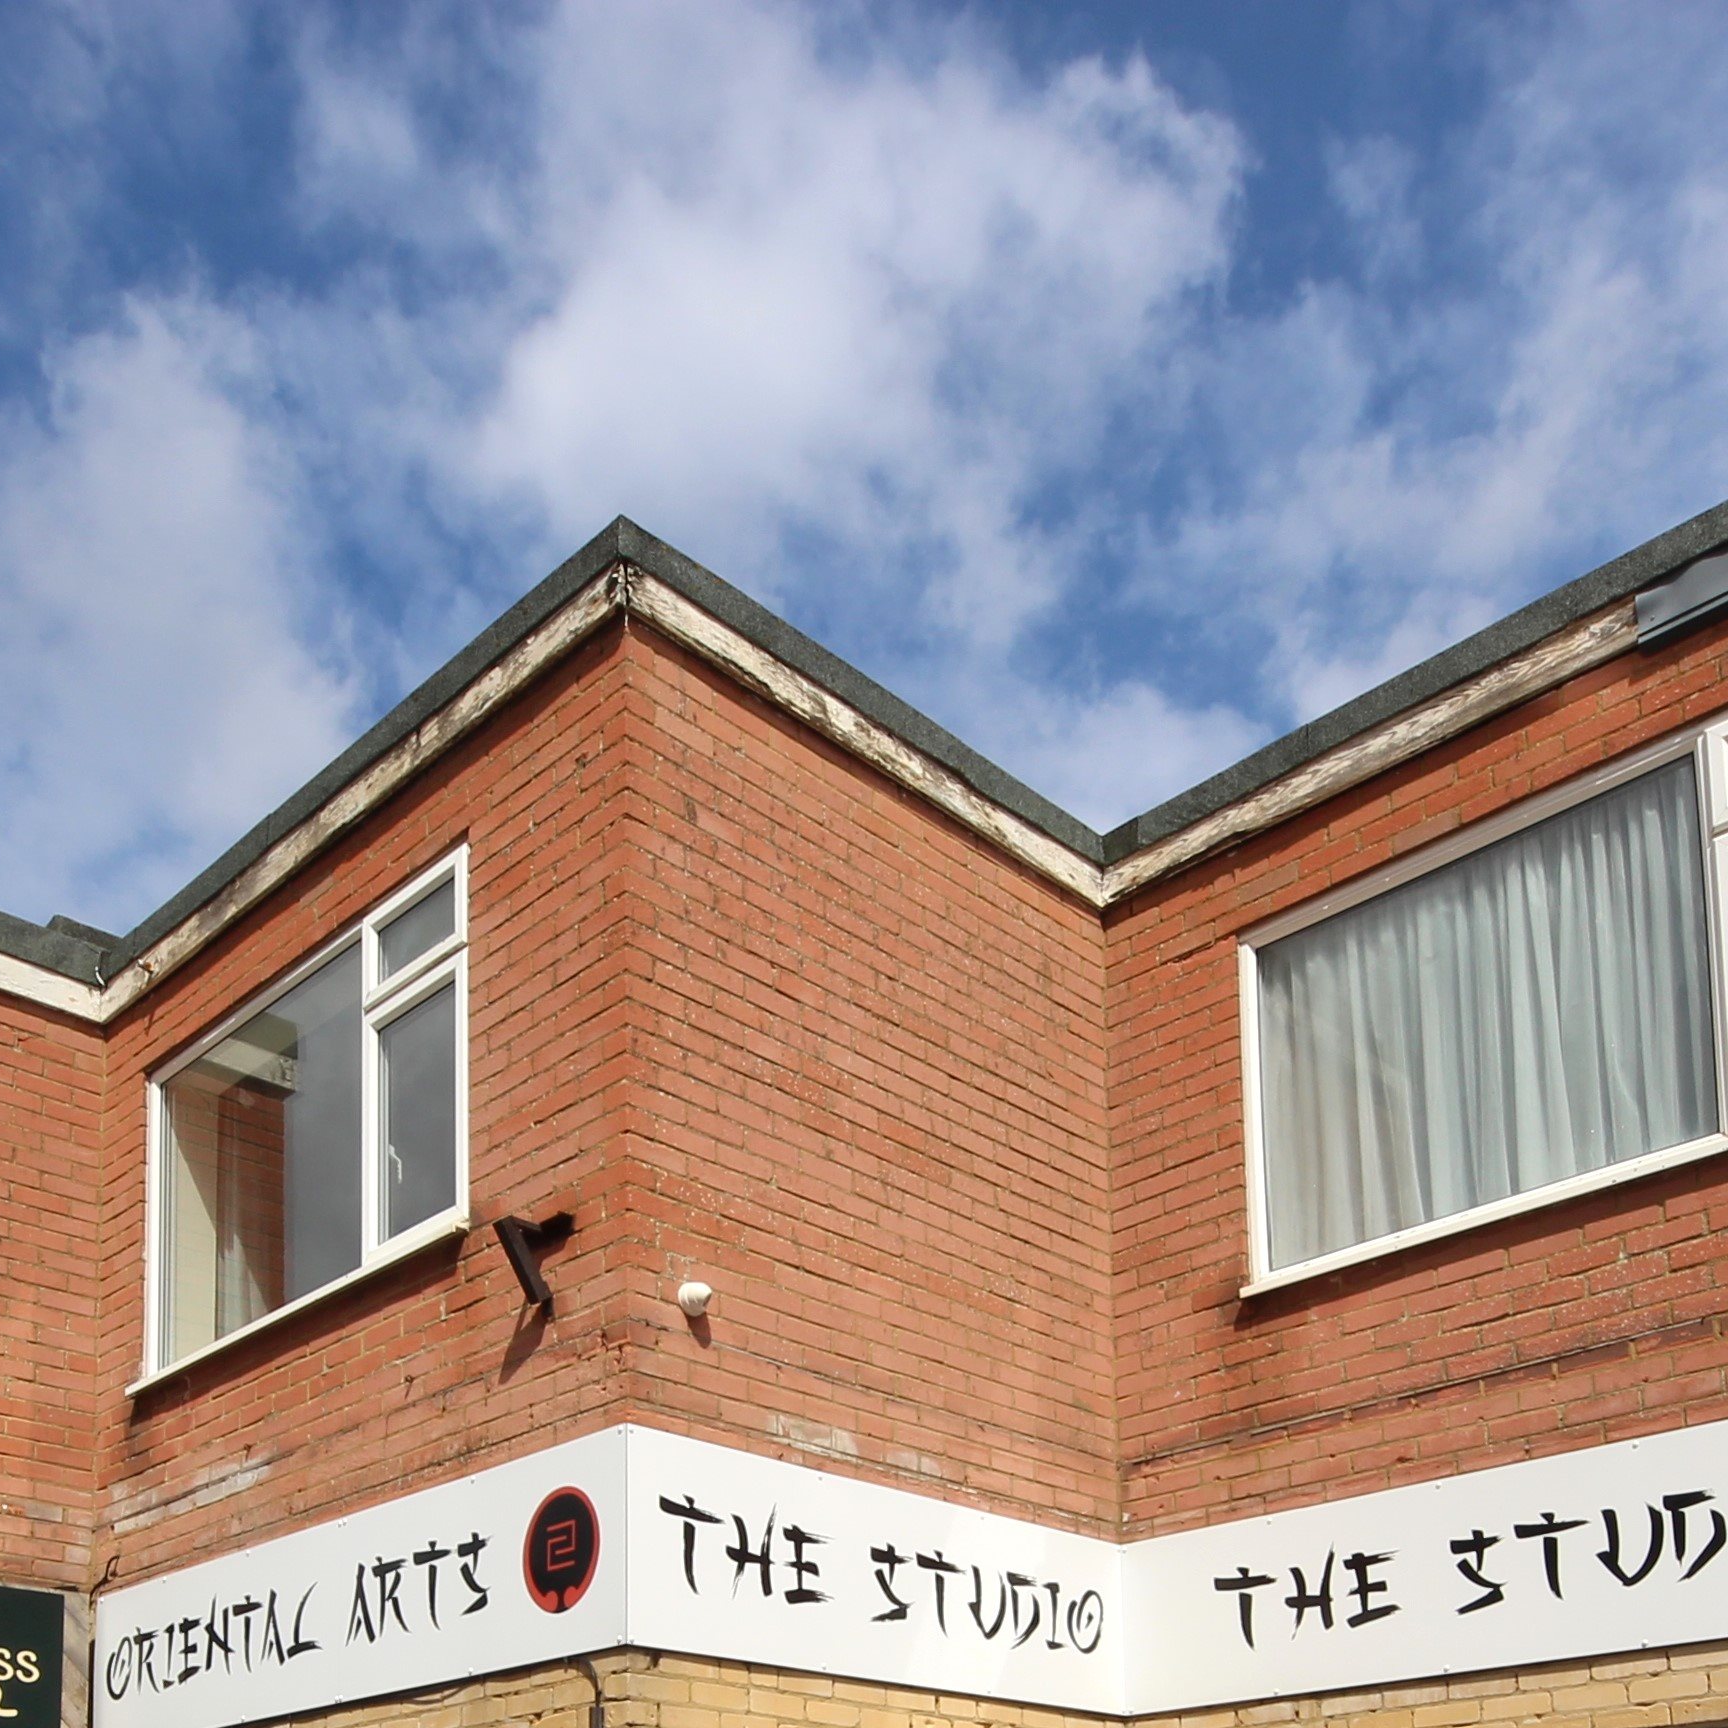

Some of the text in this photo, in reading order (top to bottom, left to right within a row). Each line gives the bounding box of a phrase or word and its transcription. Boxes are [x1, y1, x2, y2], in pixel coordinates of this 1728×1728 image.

[106, 1533, 491, 1700] ORIENTAL ARTS
[658, 1494, 1105, 1656] THE STUDIO
[1212, 1544, 1403, 1649] THE
